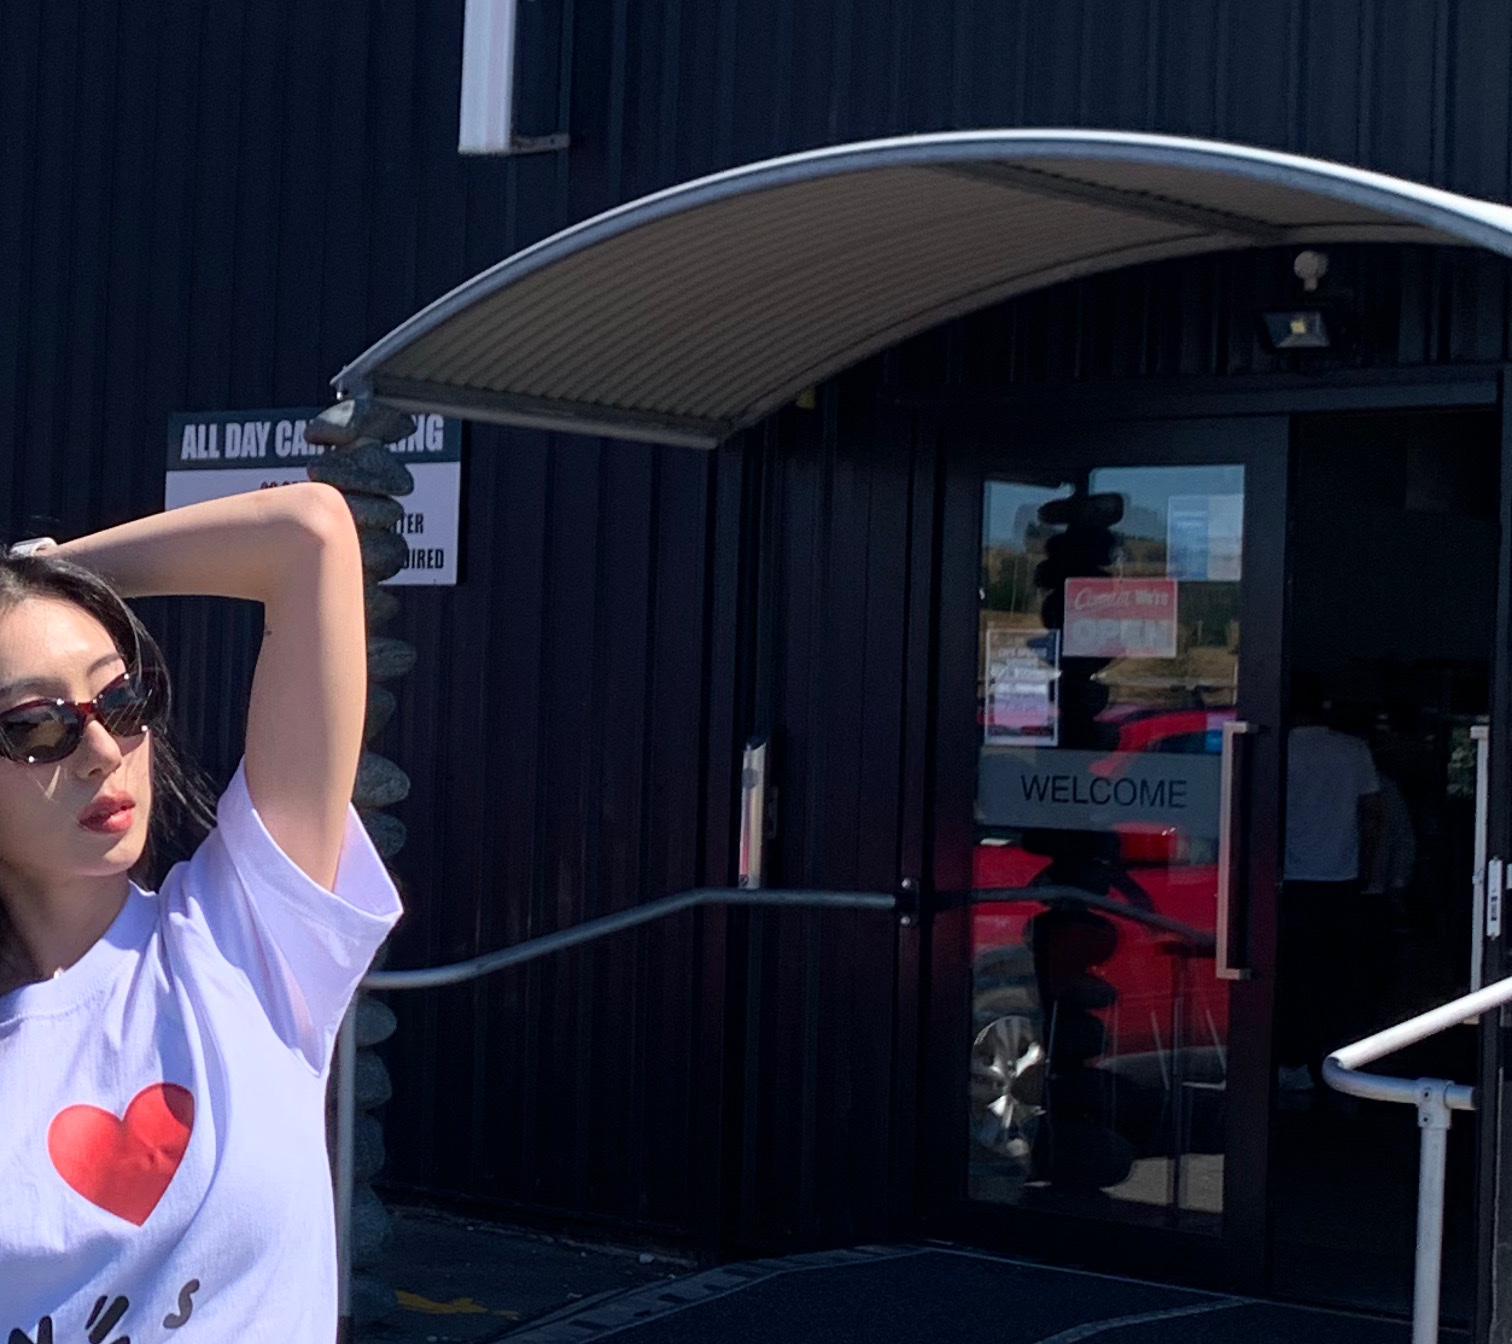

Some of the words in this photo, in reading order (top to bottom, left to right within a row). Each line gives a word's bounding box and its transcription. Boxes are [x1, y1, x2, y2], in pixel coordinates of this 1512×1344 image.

[180, 423, 220, 460] ALL
[224, 421, 271, 458] DAY
[1020, 774, 1188, 808] WELCOME
